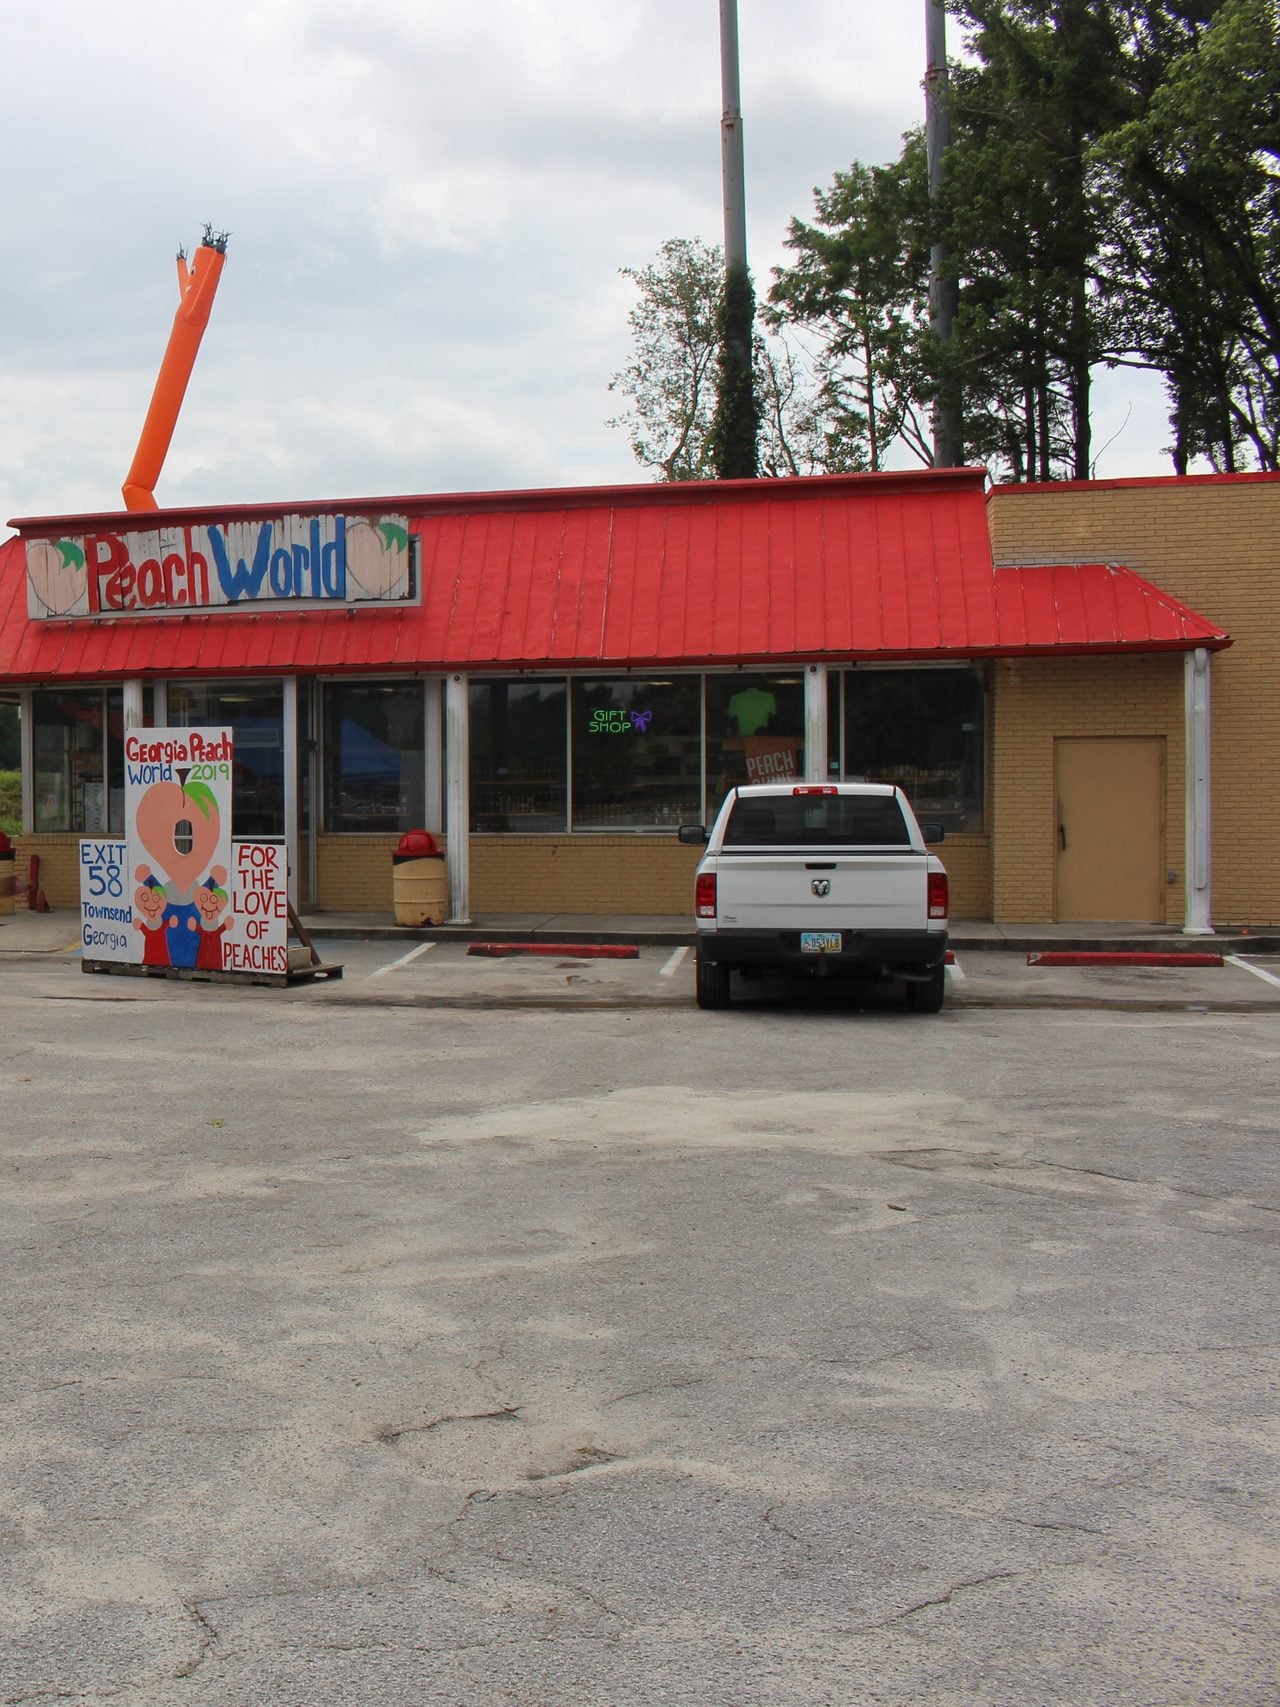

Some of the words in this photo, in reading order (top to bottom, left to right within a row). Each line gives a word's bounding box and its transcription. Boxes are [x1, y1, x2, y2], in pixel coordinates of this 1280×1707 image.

[86, 526, 209, 615] Peach
[208, 514, 345, 600] World
[594, 710, 626, 721] GIFT
[589, 721, 631, 733] SHOP
[127, 763, 172, 784] World
[191, 763, 229, 780] 2019
[746, 750, 794, 777] PEACH
[81, 844, 126, 864] EXIT
[238, 845, 279, 869] FOR
[89, 865, 122, 897] 58
[238, 869, 275, 890] THE
[82, 902, 132, 923] Townsend
[233, 891, 286, 918] LOVE
[83, 924, 128, 950] Georgia
[246, 920, 269, 940] OF
[223, 942, 288, 972] PEACHES
